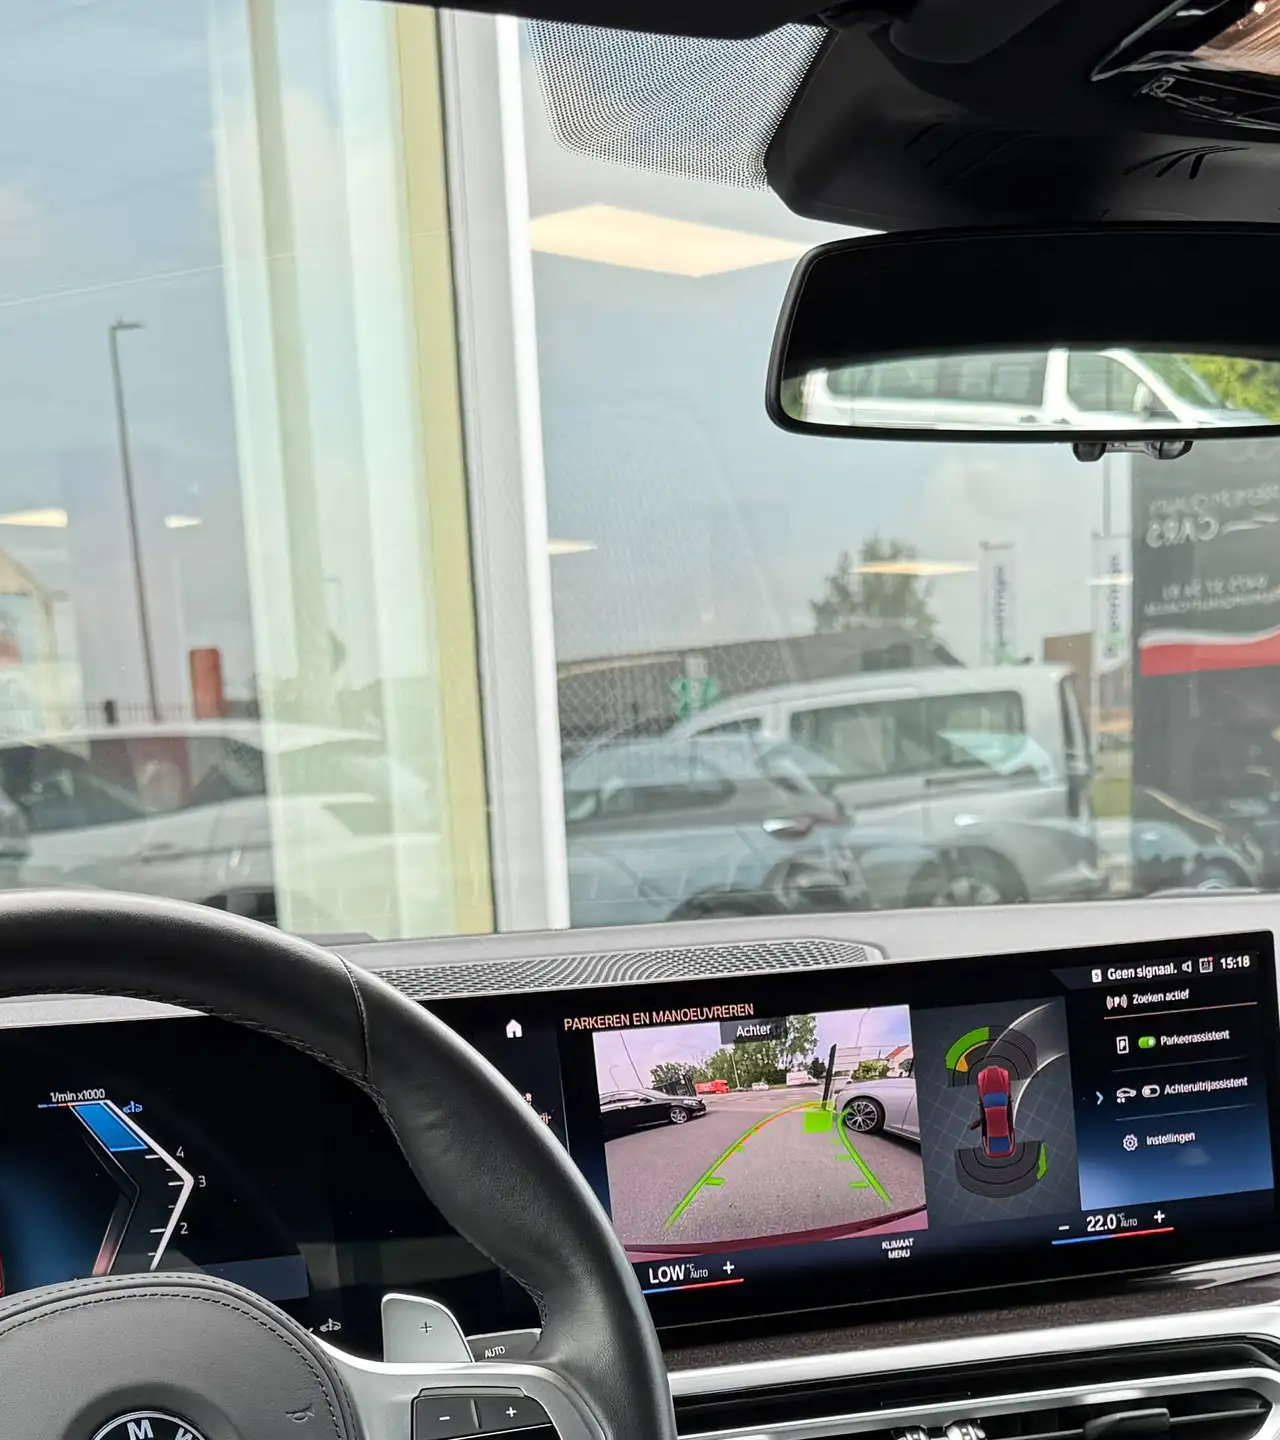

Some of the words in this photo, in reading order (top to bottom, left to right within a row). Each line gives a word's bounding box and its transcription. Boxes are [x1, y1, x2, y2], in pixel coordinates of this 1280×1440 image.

[1107, 966, 1135, 980] Geen
[1137, 962, 1177, 979] signaal.
[1220, 955, 1251, 970] 15:18
[1132, 991, 1164, 1005] Zoeken
[1166, 988, 1190, 1001] actief
[564, 1014, 630, 1031] PARKEREN
[633, 1012, 650, 1026] EN
[652, 1003, 754, 1024] MANOEUVREREN
[736, 1024, 772, 1038] Achter
[1160, 1029, 1230, 1046] Parkeerassistent
[1164, 1076, 1248, 1095] Achteruitrijassistent
[50, 1090, 77, 1102] 1/min
[77, 1088, 106, 1101] x1000
[1146, 1131, 1196, 1147] Instellingen
[176, 1146, 185, 1158] 4
[198, 1175, 207, 1188] 3
[180, 1223, 189, 1235] 2
[1086, 1213, 1117, 1232] 22.0
[1120, 1218, 1138, 1228] AUTO
[881, 1238, 914, 1250] KLIMAAT
[888, 1249, 911, 1259] MENU
[649, 1264, 685, 1284] LOW
[690, 1269, 709, 1280] AUTO
[484, 1345, 506, 1358] AUTO
